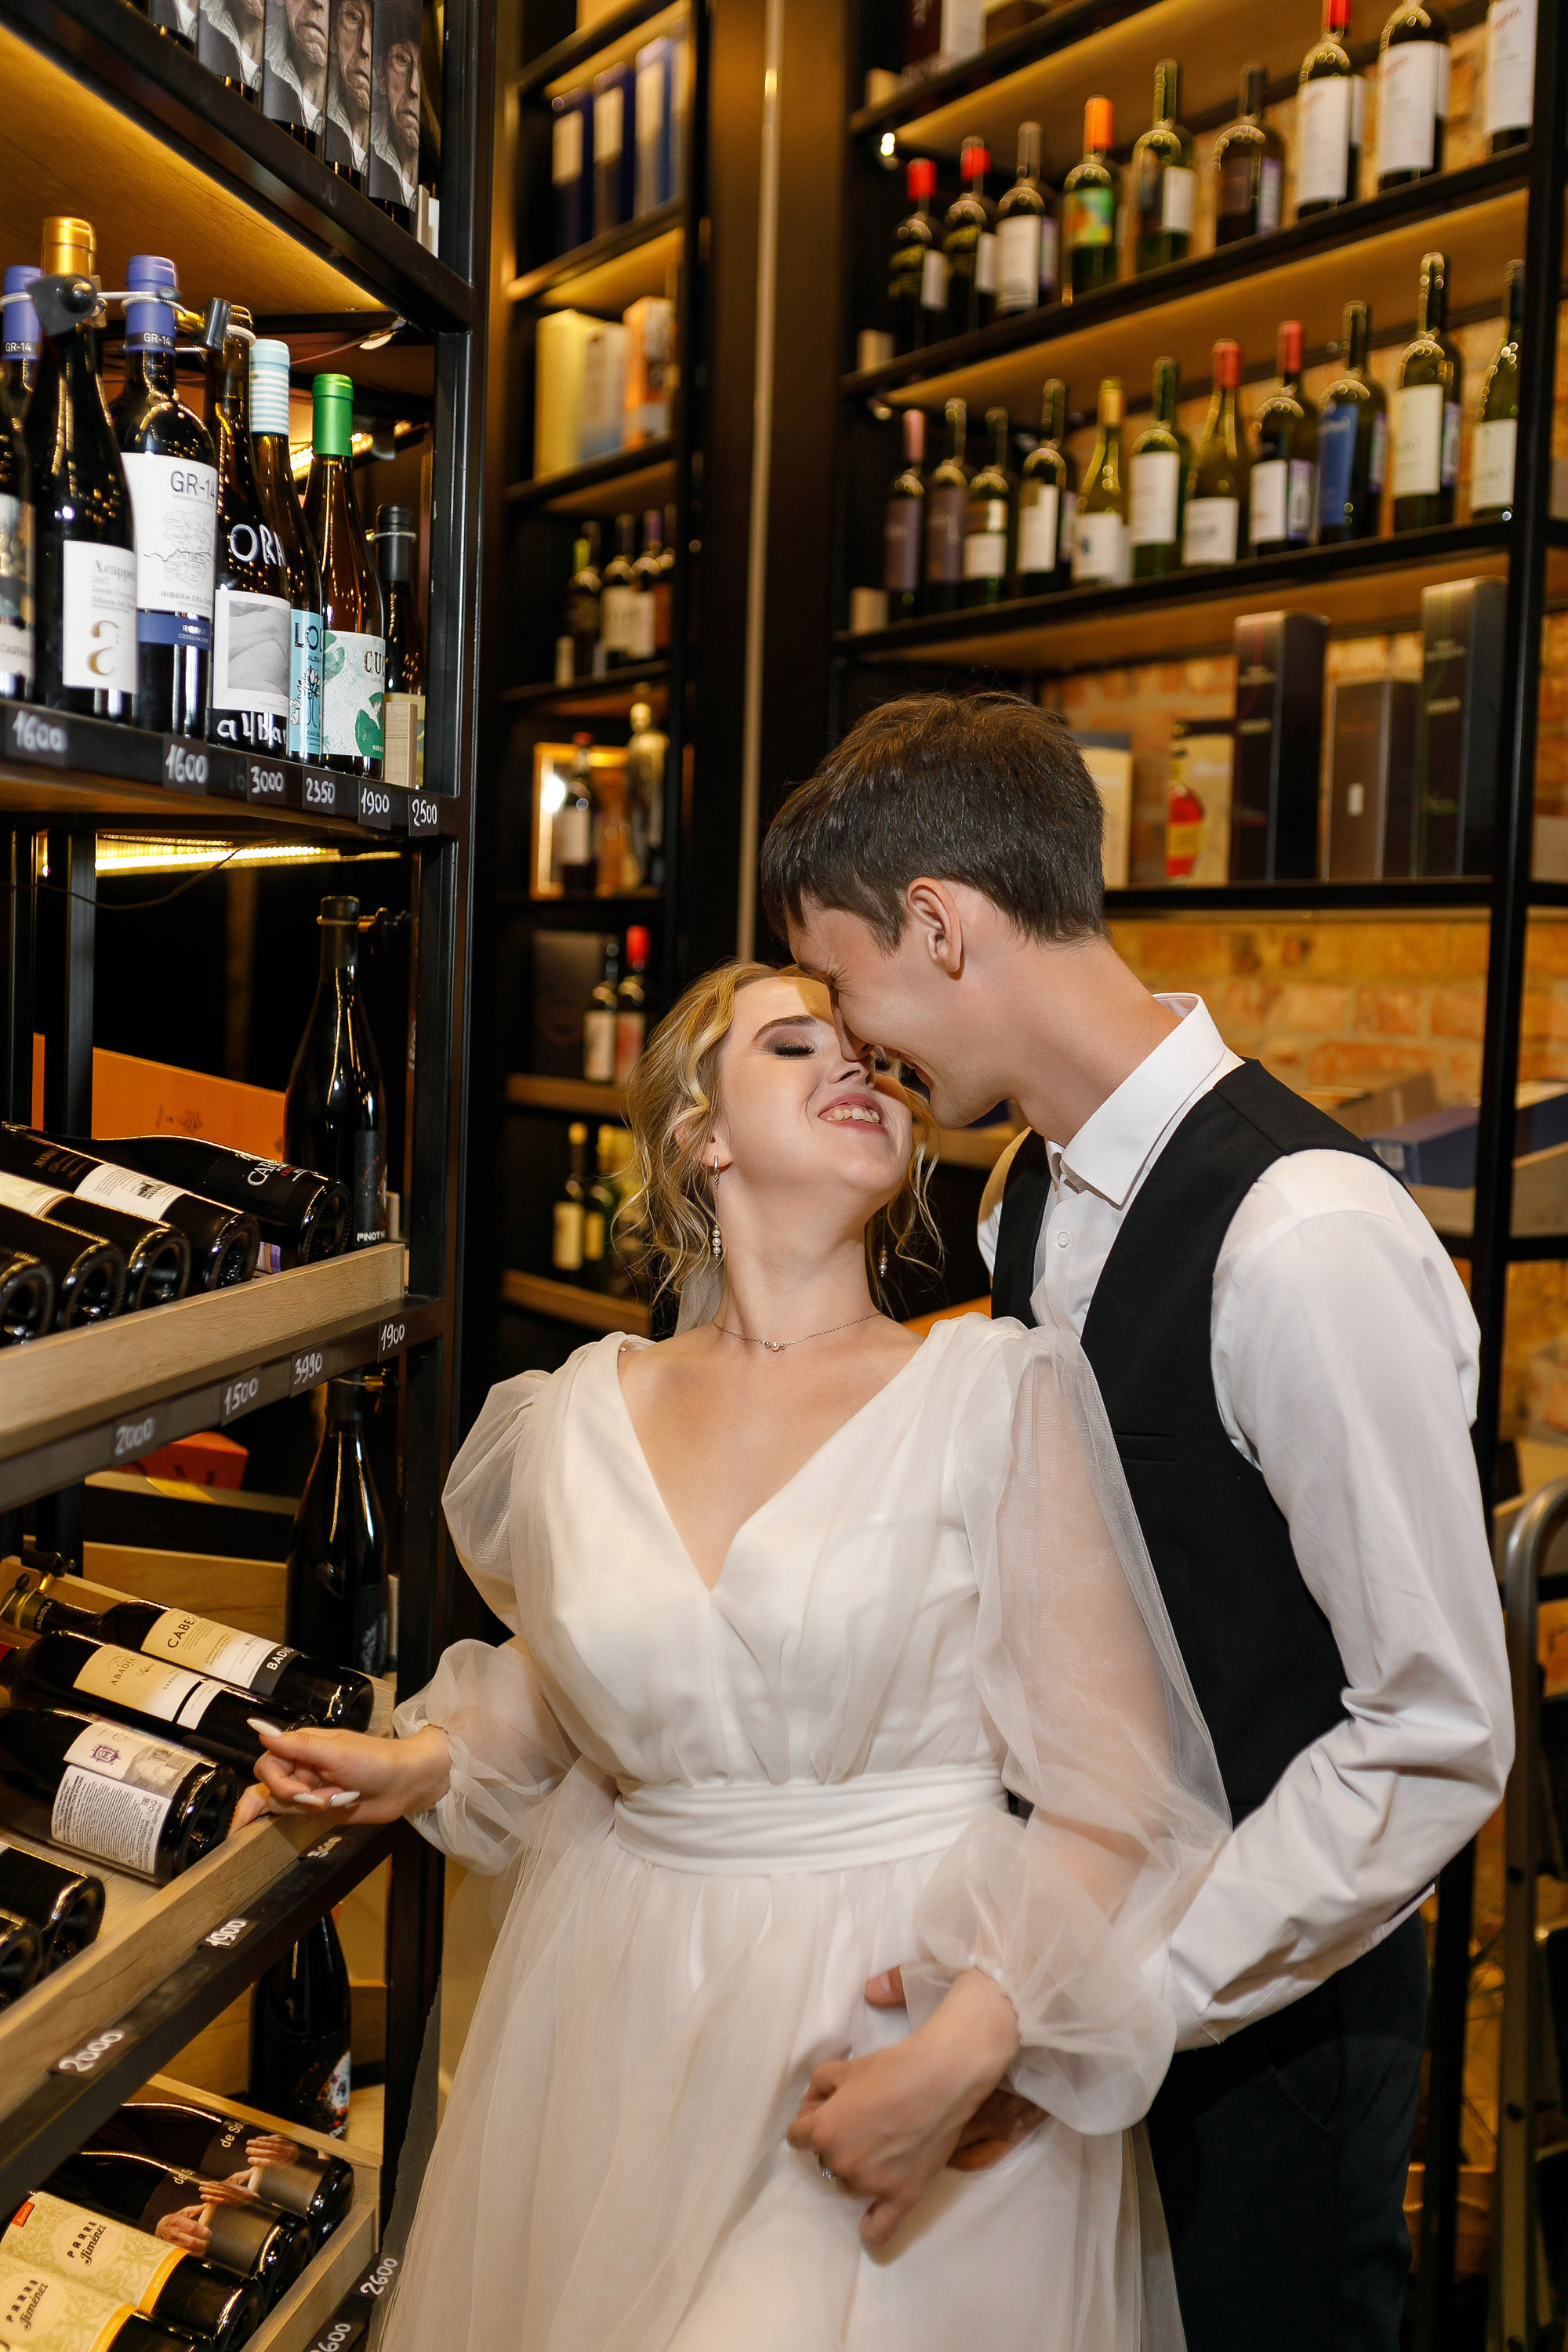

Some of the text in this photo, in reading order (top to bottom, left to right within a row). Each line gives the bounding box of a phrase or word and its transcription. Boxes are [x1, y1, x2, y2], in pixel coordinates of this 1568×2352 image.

[5, 342, 32, 352] GR-14
[143, 332, 172, 346] GR-14
[170, 470, 216, 499] GR-14
[161, 590, 190, 601] RIBERA
[12, 710, 68, 753] 1600
[165, 744, 209, 784] 1600
[250, 765, 285, 793] 3000
[306, 777, 336, 804] 2350
[361, 787, 390, 815] 1900
[412, 798, 437, 827] 2500
[380, 1323, 406, 1352] 1900
[223, 1377, 260, 1416] 1500
[114, 1417, 156, 1457] 2000
[205, 1918, 248, 1947] 1900
[58, 2029, 125, 2072] 2000
[220, 2134, 235, 2148] de
[67, 2220, 97, 2259] PARRA
[80, 2223, 107, 2267] Jiménez
[360, 2258, 398, 2296] 2600
[6, 2279, 39, 2323] PARRA
[19, 2282, 49, 2332] Jiménez
[310, 2323, 351, 2352] 600
